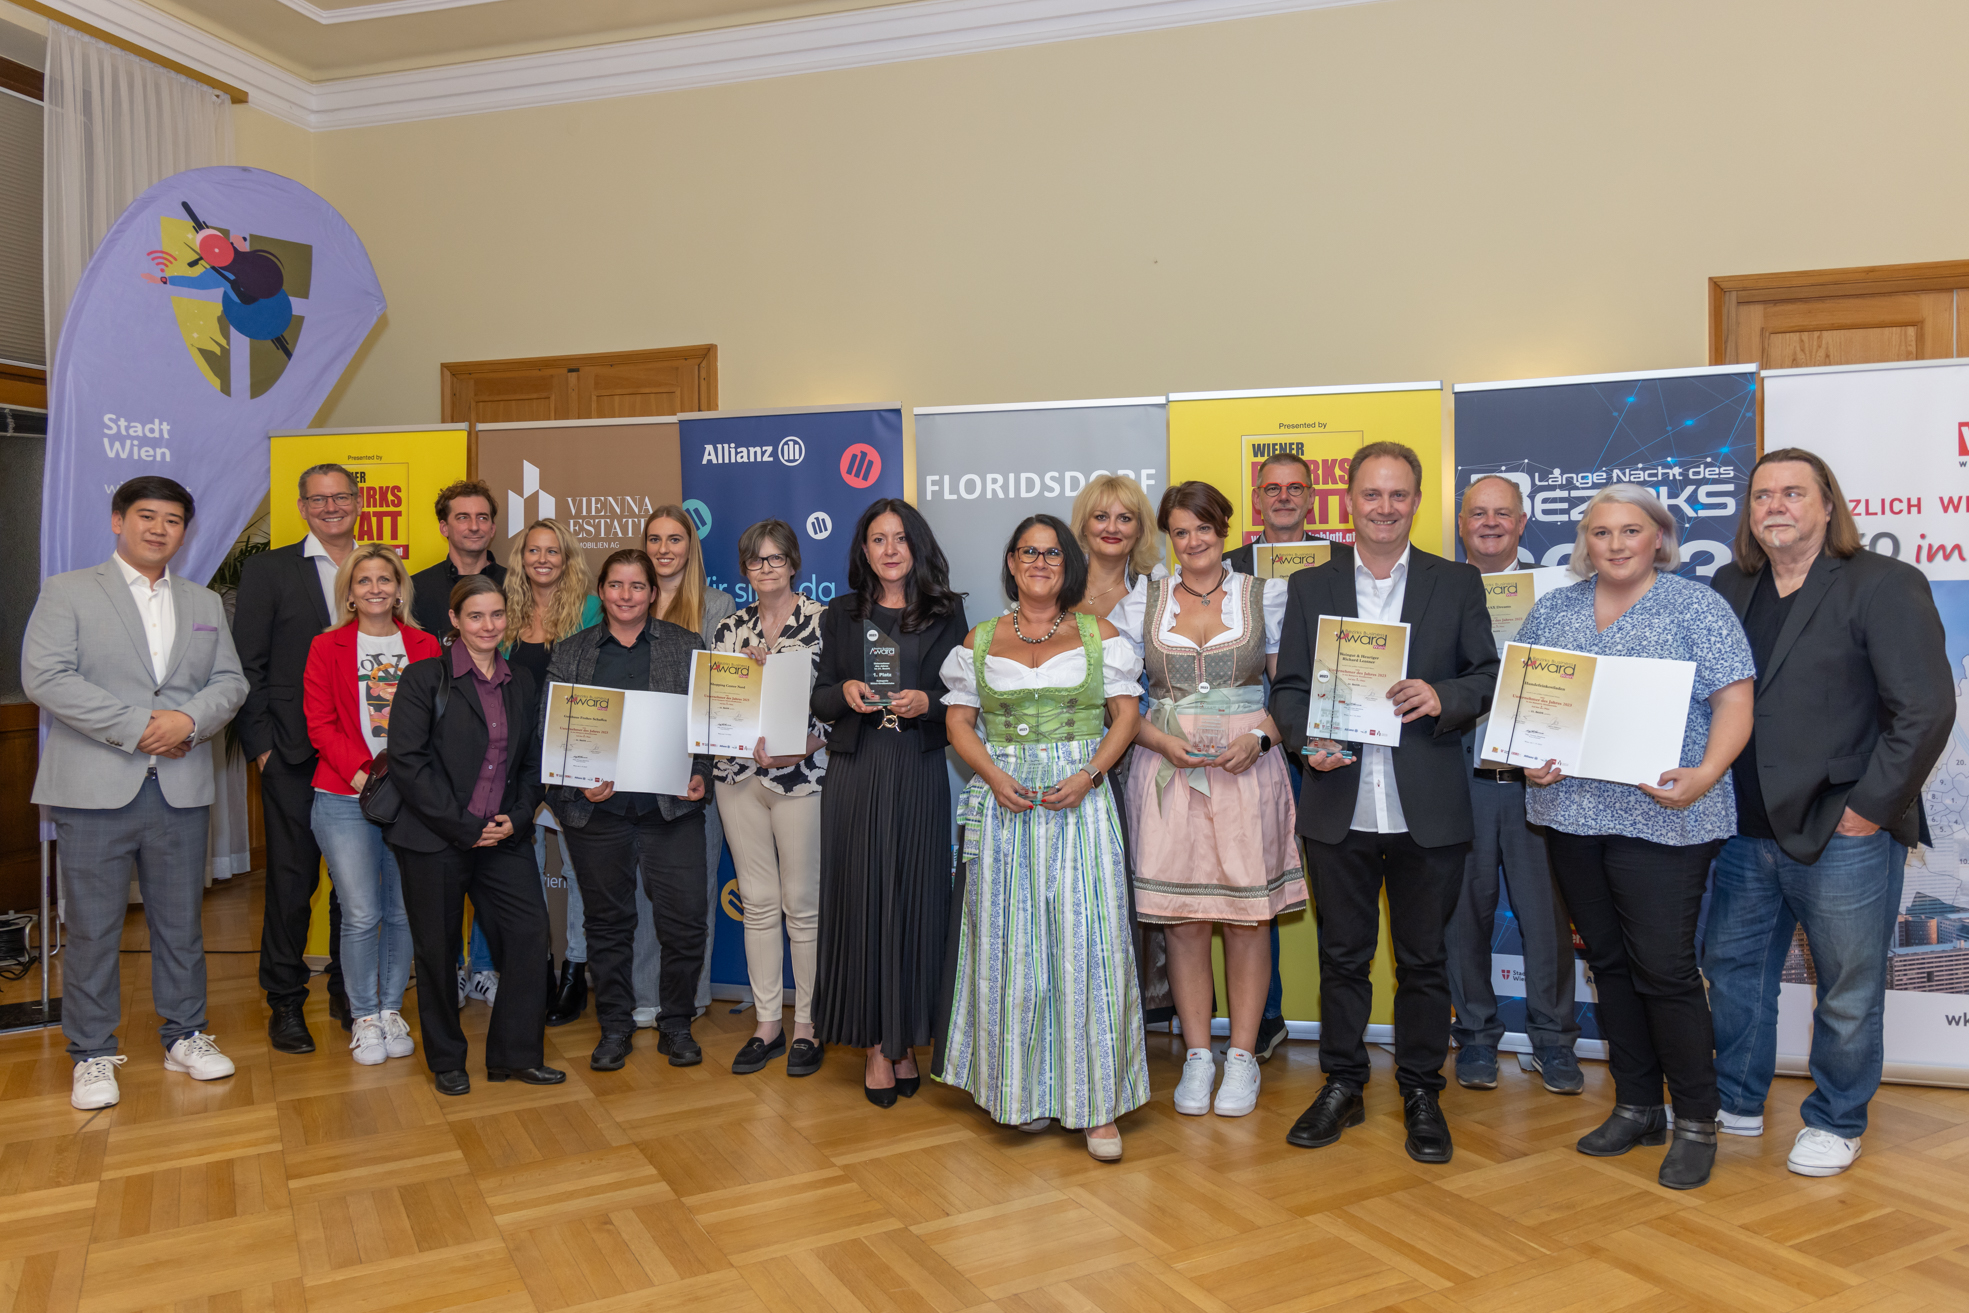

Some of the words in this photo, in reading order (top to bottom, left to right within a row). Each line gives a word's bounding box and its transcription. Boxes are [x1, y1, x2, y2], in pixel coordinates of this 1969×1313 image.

[103, 414, 170, 438] Stadt
[1318, 422, 1327, 430] by
[103, 438, 170, 462] Wien
[702, 442, 774, 464] Allianz
[1252, 442, 1304, 458] WIENER
[926, 468, 1156, 500] FLORIDSDF
[1534, 470, 1606, 488] Lange
[1613, 466, 1683, 482] Nacht
[1688, 464, 1734, 478] des
[566, 496, 653, 516] VIENNA
[1848, 496, 1922, 516] ZLICH
[354, 510, 402, 542] ATT
[1915, 532, 1966, 564] im
[1272, 553, 1315, 565] Award
[799, 574, 836, 602] da
[1336, 629, 1388, 646] Award
[710, 661, 750, 676] Award
[1522, 656, 1576, 676] Award
[566, 694, 609, 708] Award
